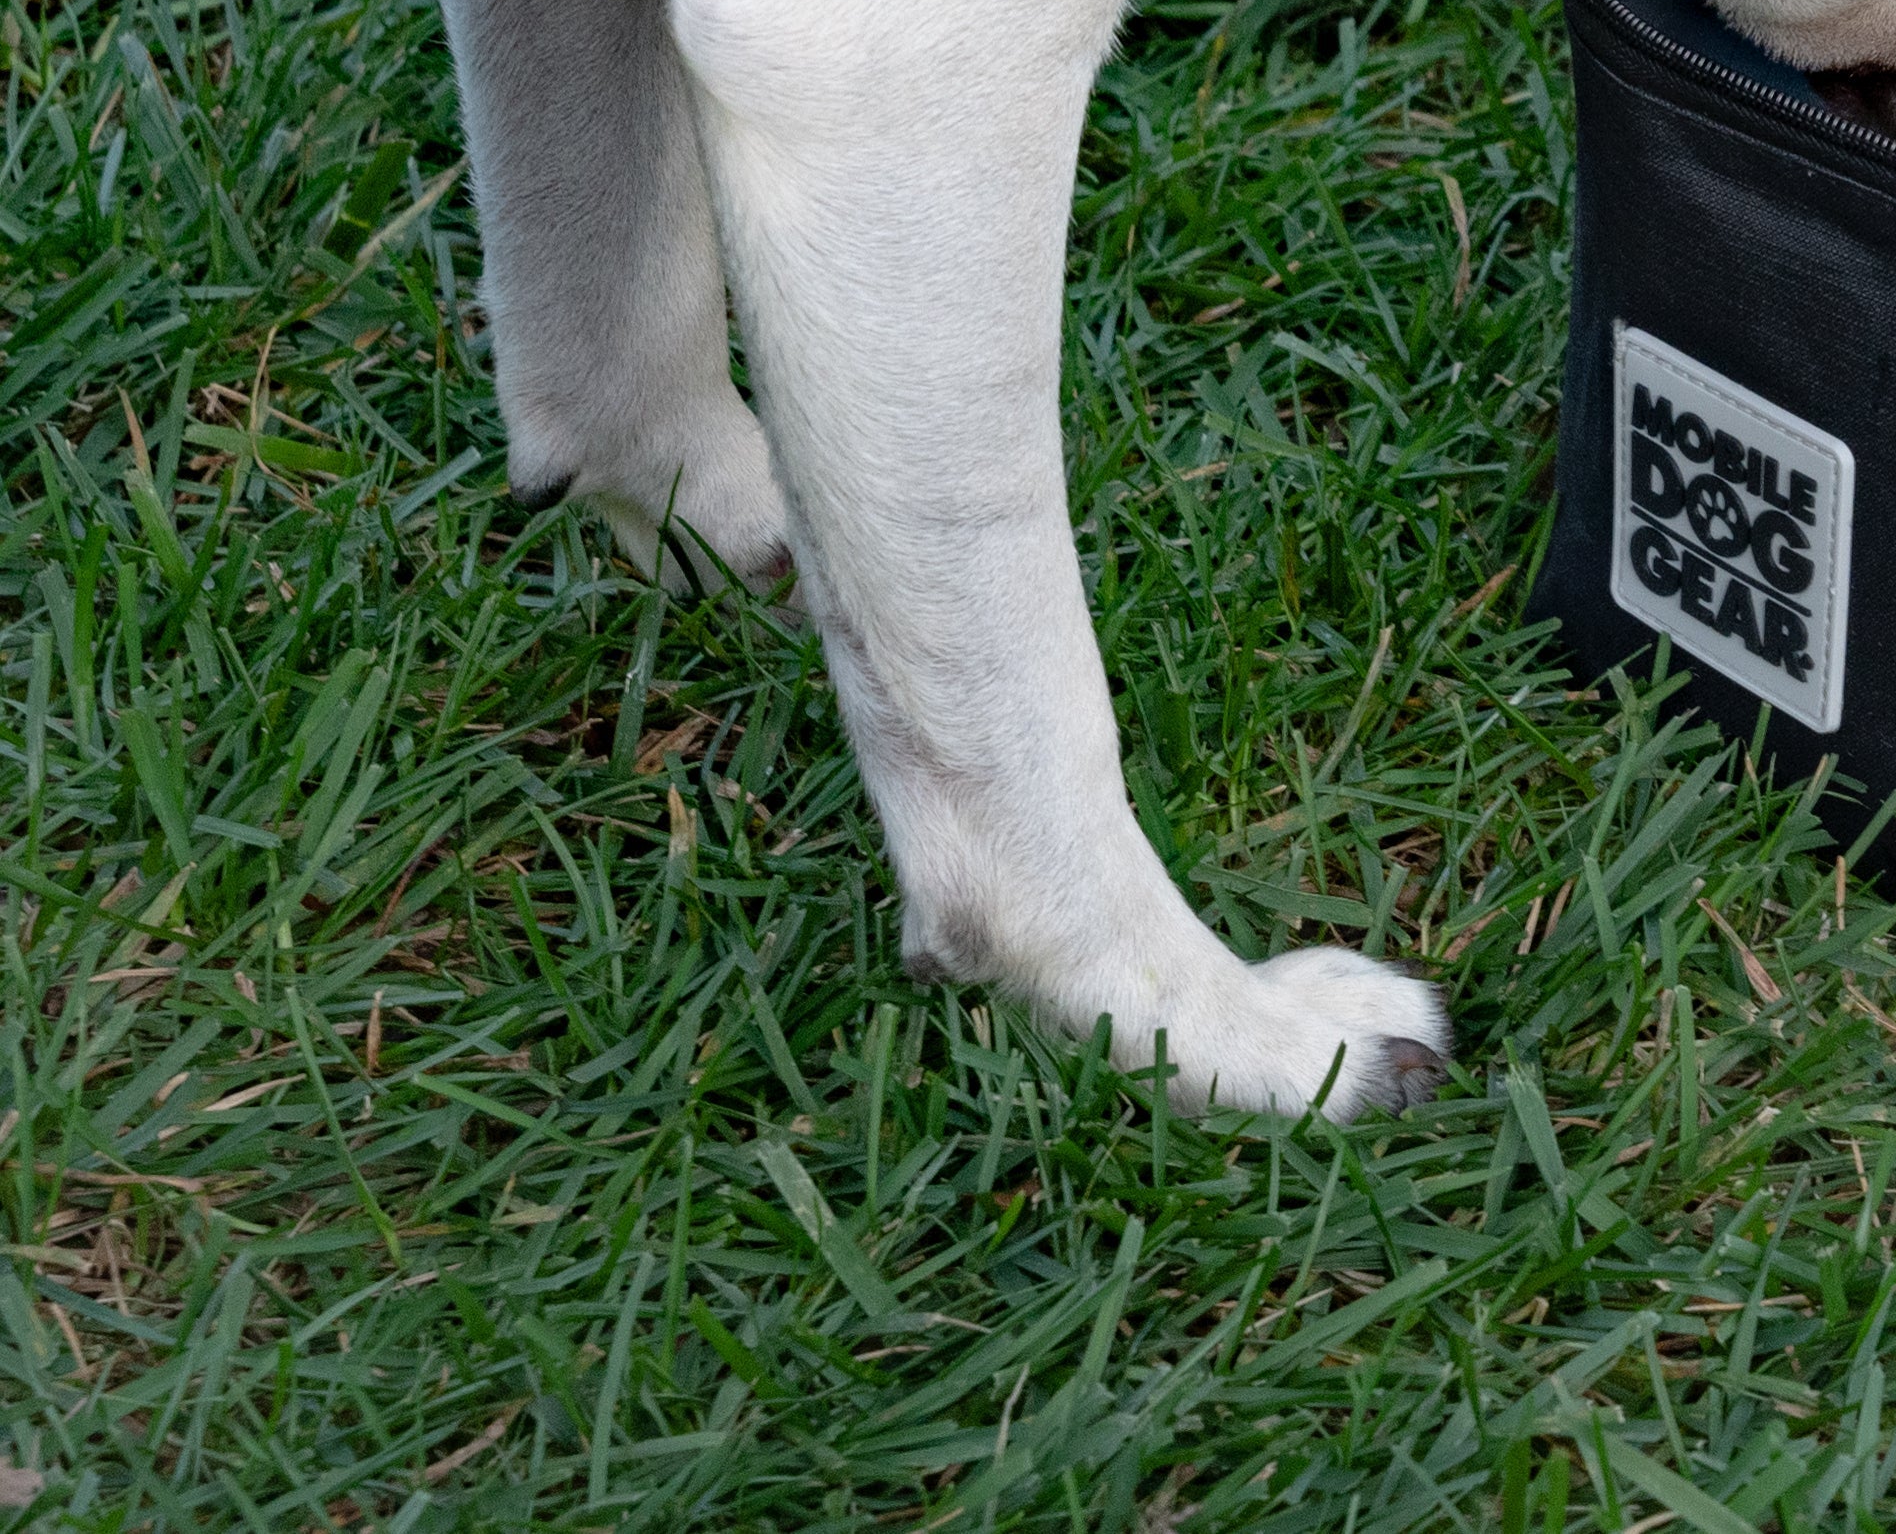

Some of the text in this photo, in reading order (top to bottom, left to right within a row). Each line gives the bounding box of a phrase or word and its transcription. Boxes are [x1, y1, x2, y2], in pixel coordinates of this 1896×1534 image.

[1631, 382, 1818, 526] MOBILE
[1631, 430, 1814, 594] DOG
[1630, 525, 1814, 683] GEAR
